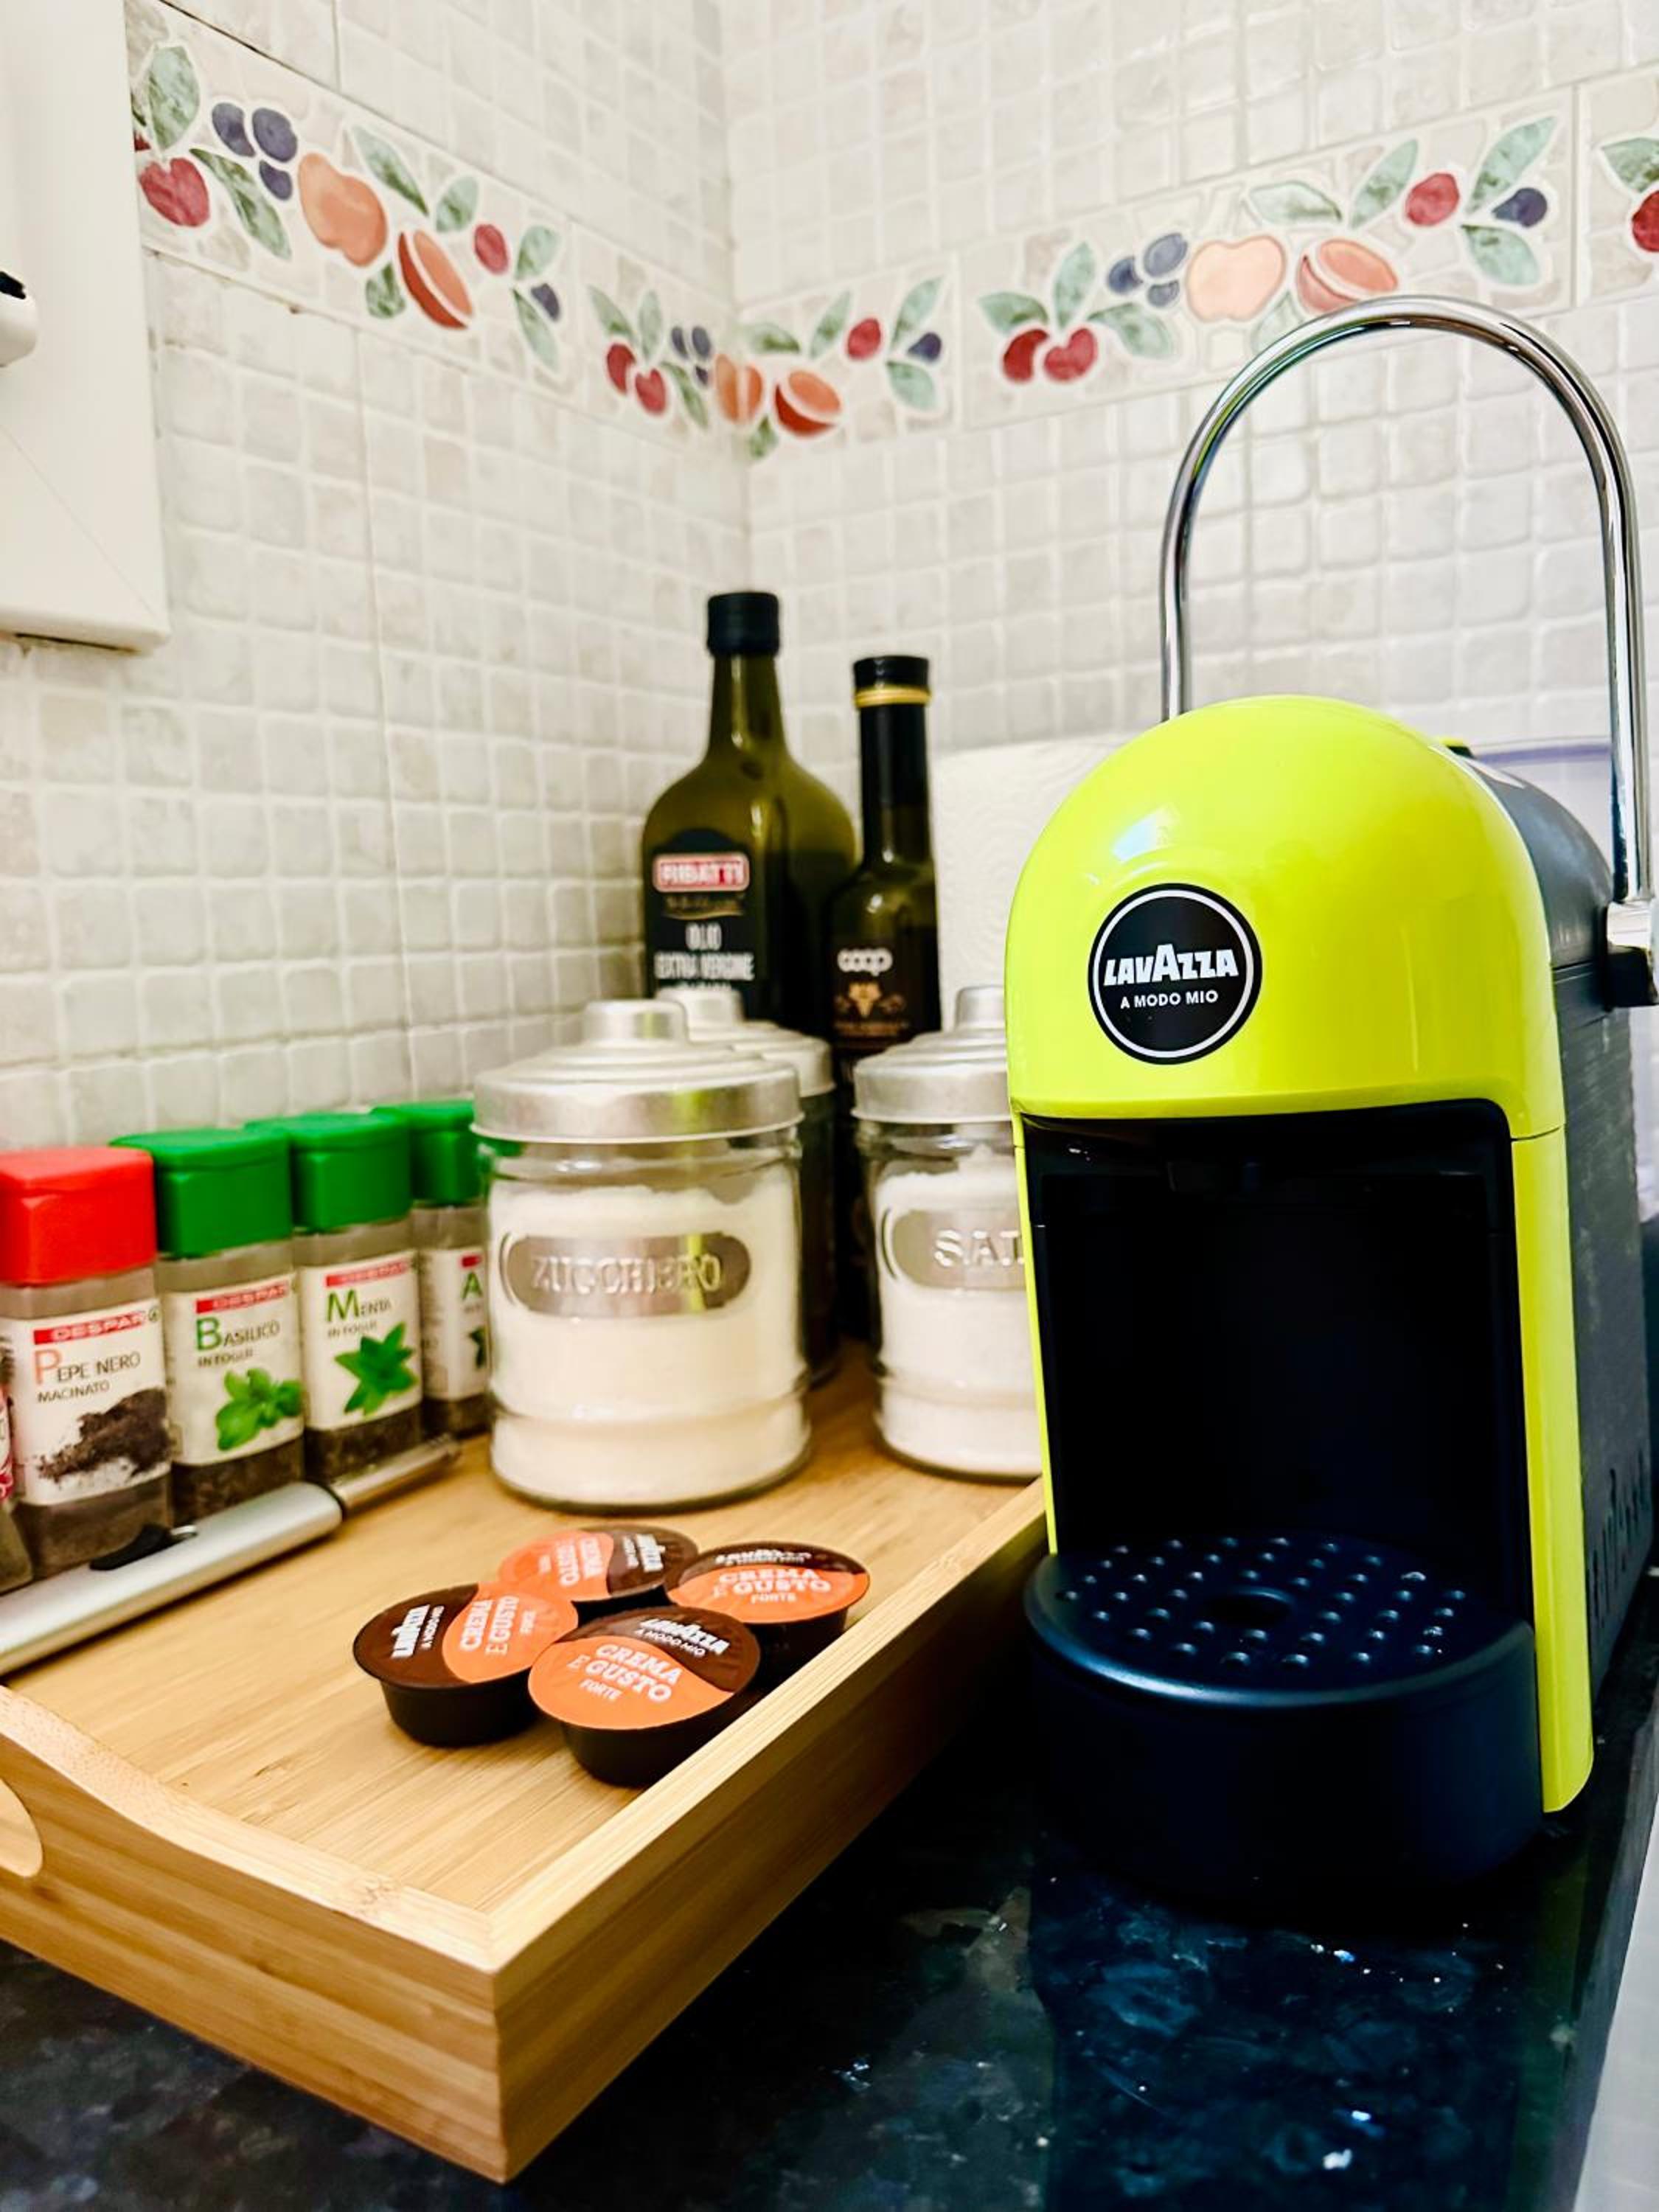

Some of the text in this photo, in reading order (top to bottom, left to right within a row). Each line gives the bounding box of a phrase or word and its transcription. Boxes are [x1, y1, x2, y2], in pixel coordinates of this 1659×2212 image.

[837, 948, 893, 977] coop
[1104, 943, 1239, 986] LAVAZZA
[1121, 990, 1218, 1009] A MODO MIO
[196, 1318, 280, 1351] BASILICO
[35, 1349, 140, 1386] PEPE NERO
[38, 1380, 110, 1402] MACINATO
[585, 1659, 672, 1703] GUSTO
[596, 1644, 683, 1686] CREMA
